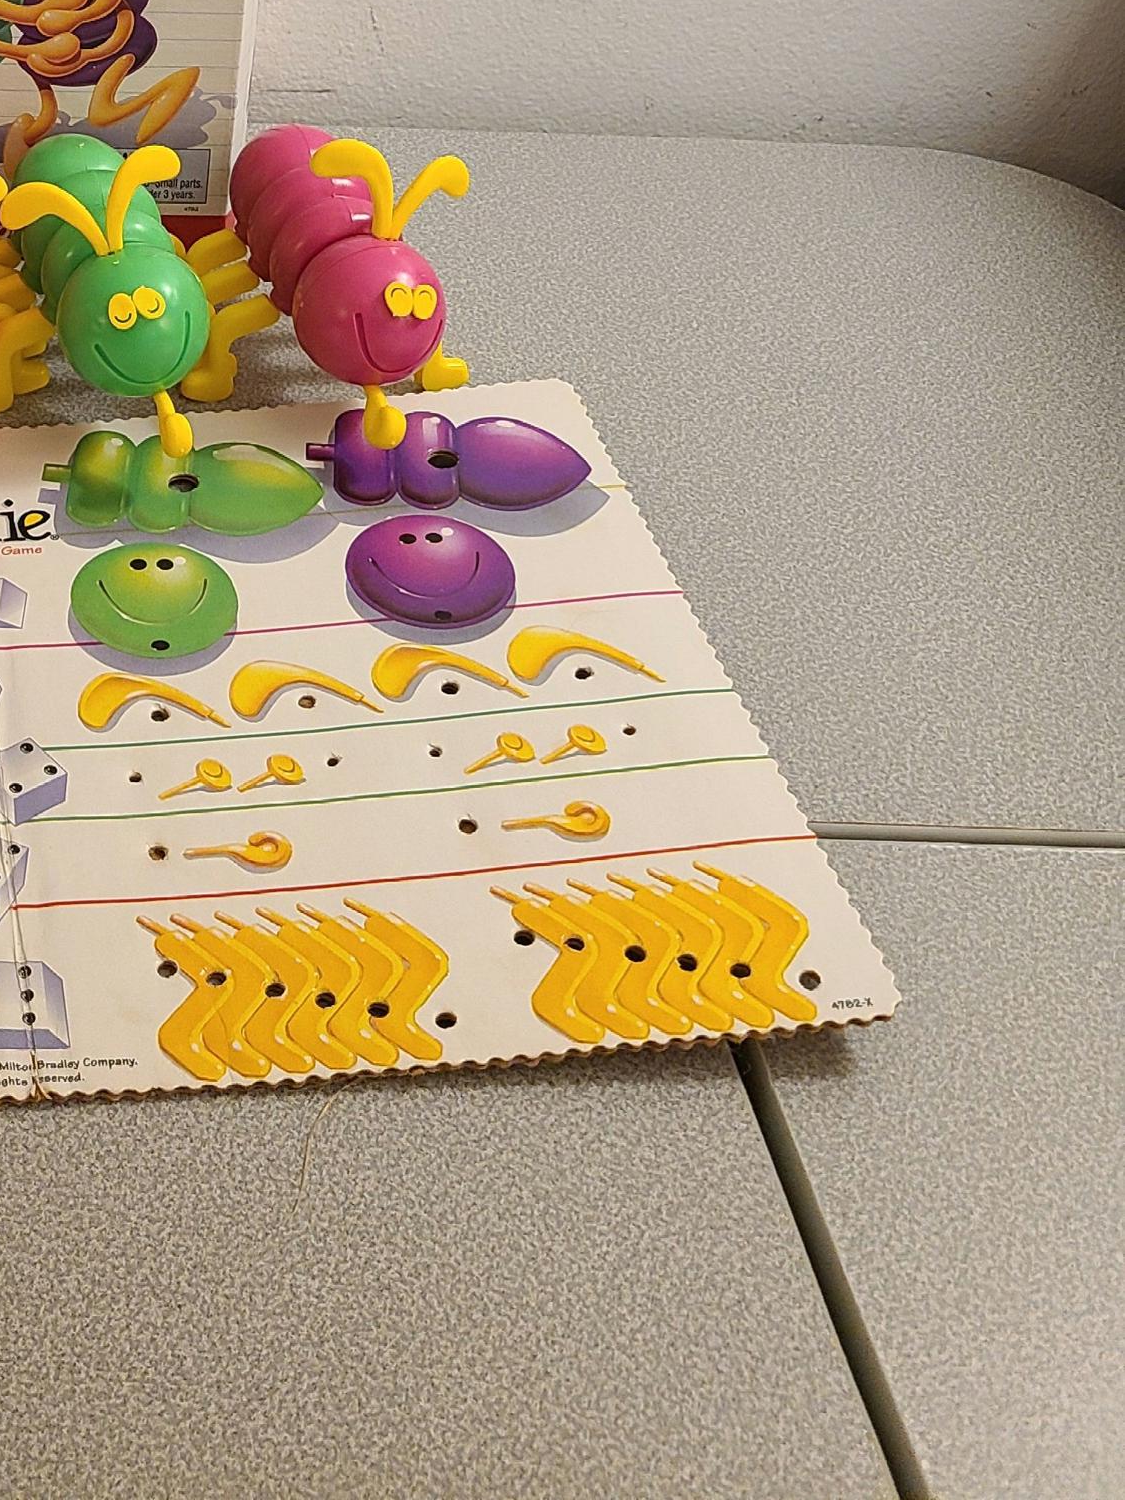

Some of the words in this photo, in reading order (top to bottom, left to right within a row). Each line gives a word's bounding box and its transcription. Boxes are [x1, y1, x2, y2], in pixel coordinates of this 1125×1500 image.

[180, 179, 203, 190] parts.
[162, 190, 169, 199] 3
[171, 190, 196, 200] years.
[1, 546, 43, 556] Game
[37, 1059, 80, 1070] Bradley
[83, 1057, 138, 1068] Company.
